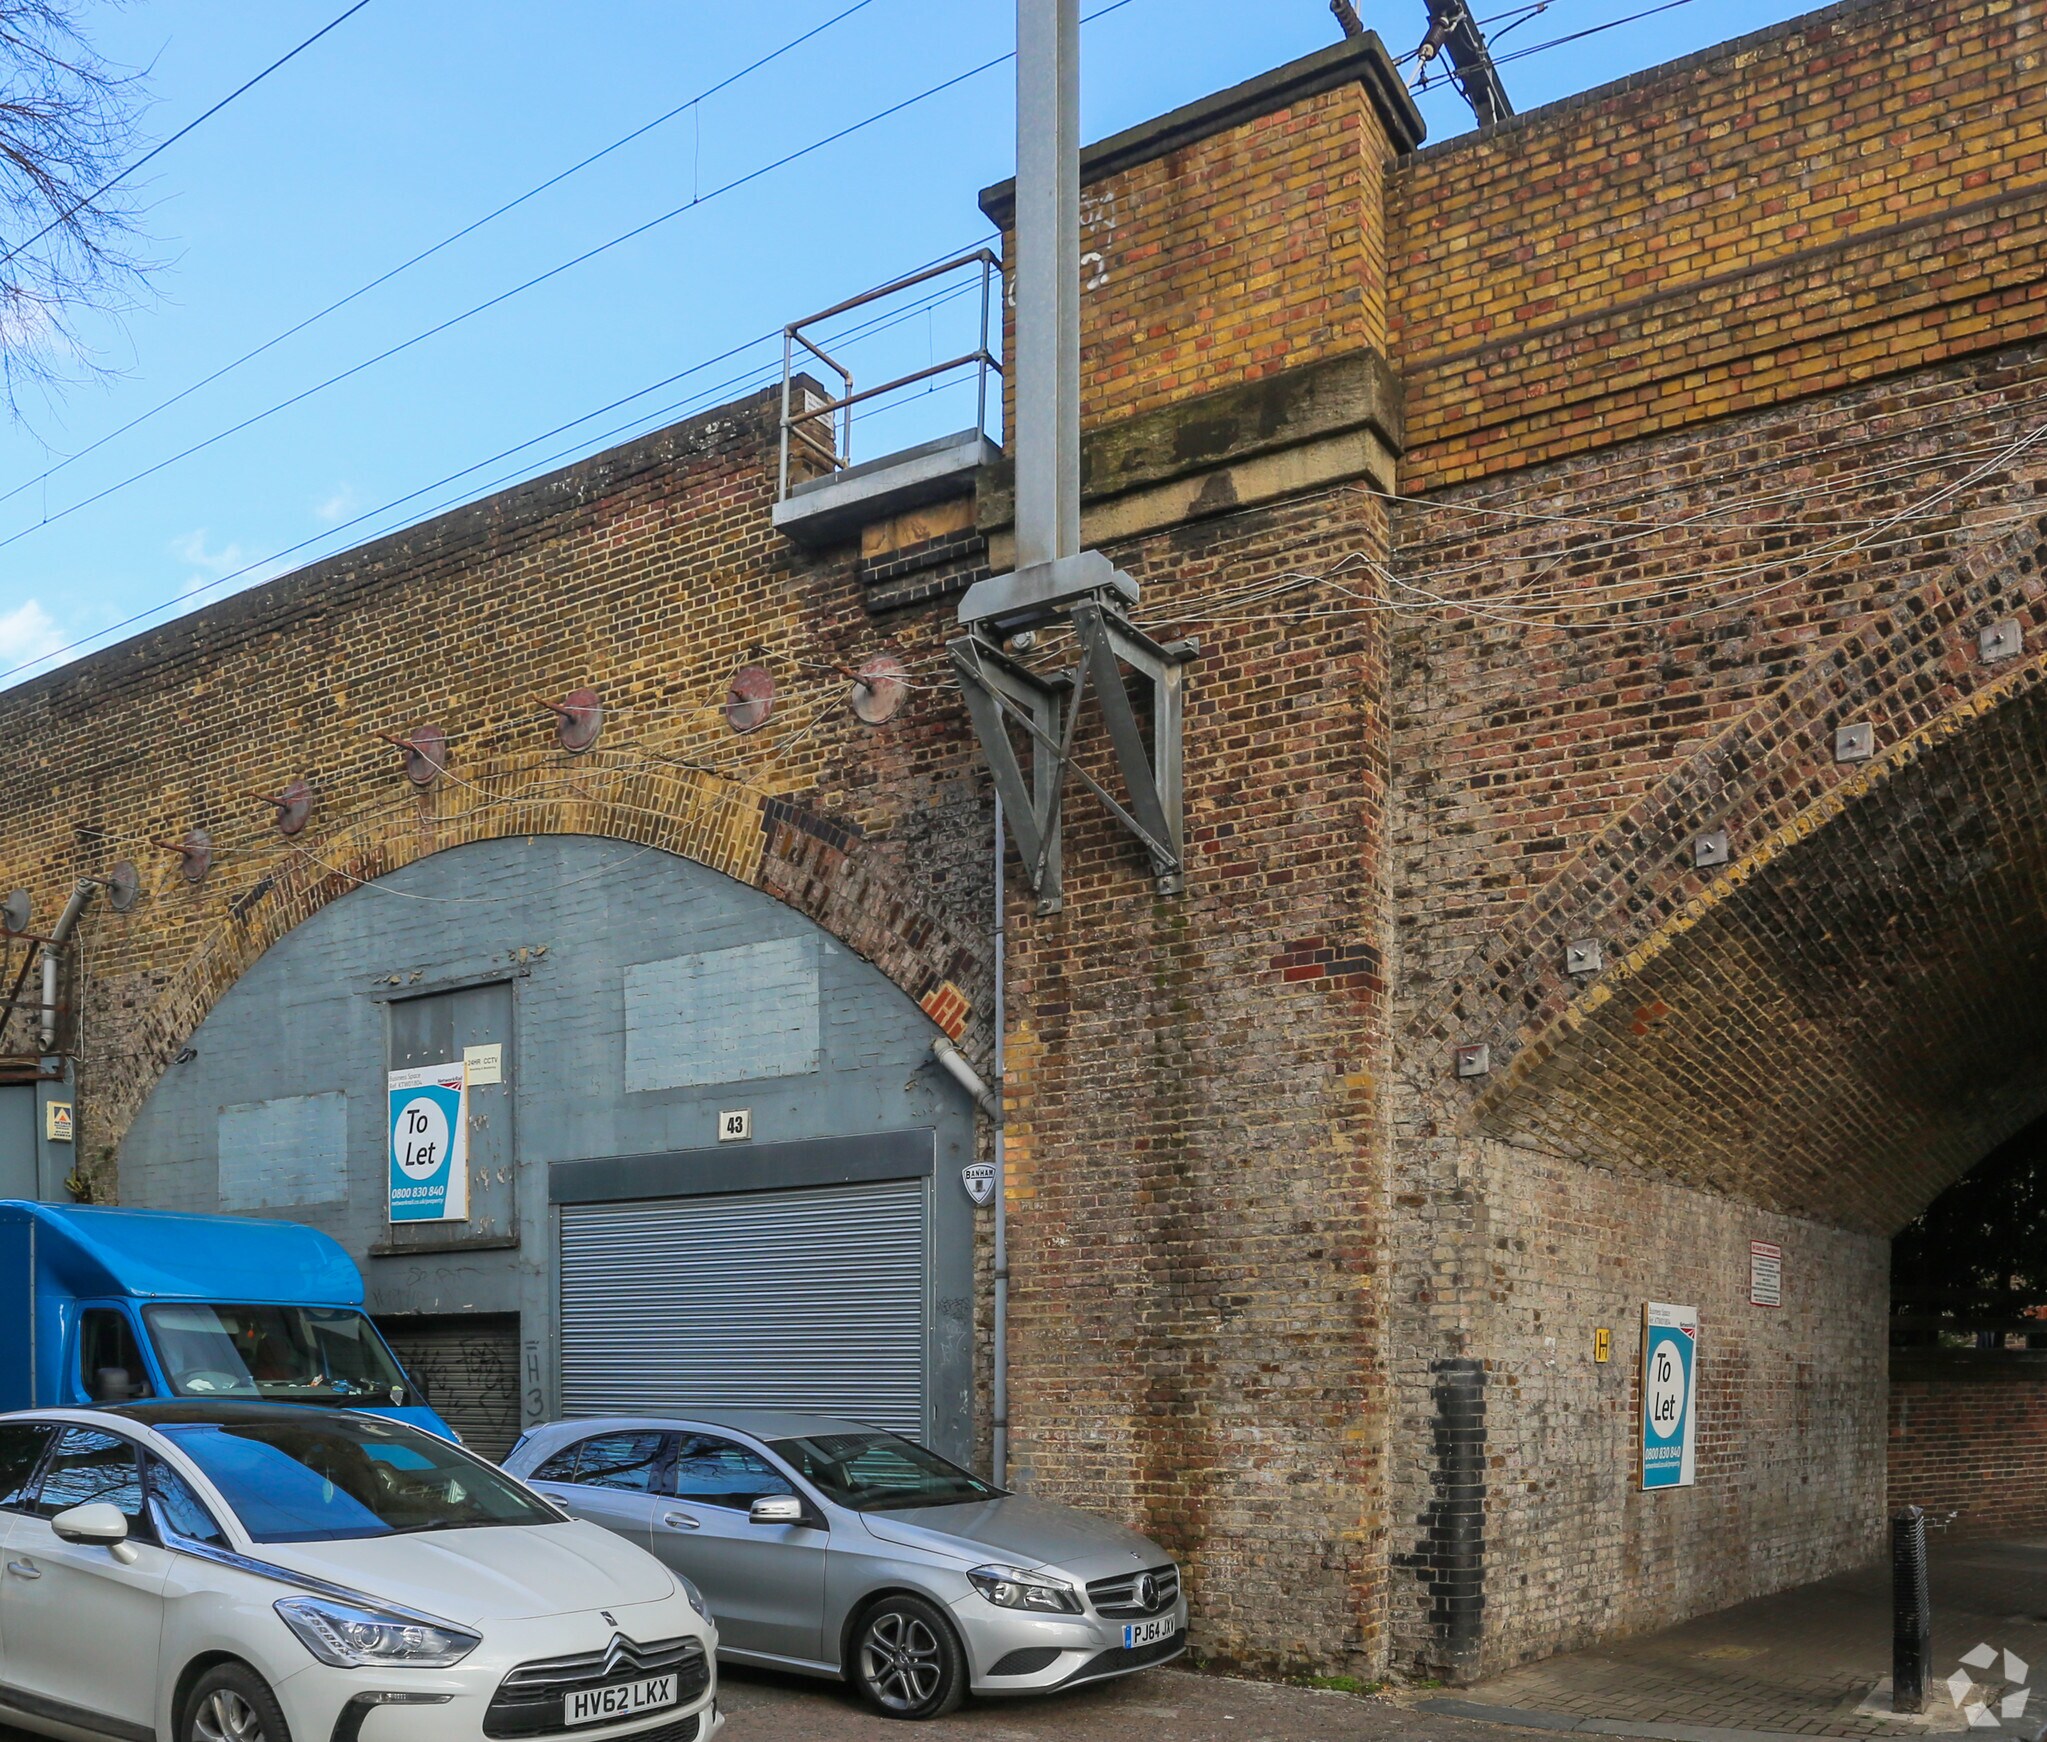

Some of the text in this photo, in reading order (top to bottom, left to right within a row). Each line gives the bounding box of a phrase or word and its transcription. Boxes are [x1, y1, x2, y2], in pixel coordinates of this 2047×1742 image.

[484, 1057, 498, 1065] CCTV
[408, 1073, 421, 1081] Space
[407, 1109, 428, 1134] To
[727, 1116, 743, 1134] 43
[405, 1142, 436, 1167] Let
[965, 1169, 994, 1179] BANHAM
[392, 1185, 444, 1199] 0800 830 840
[1599, 1332, 1608, 1358] H
[1657, 1353, 1671, 1383] To
[1654, 1392, 1675, 1421] Let
[1645, 1445, 1681, 1461] 0800 830 840
[1134, 1621, 1160, 1644] PJ64
[575, 1678, 670, 1718] HV62 LKX
